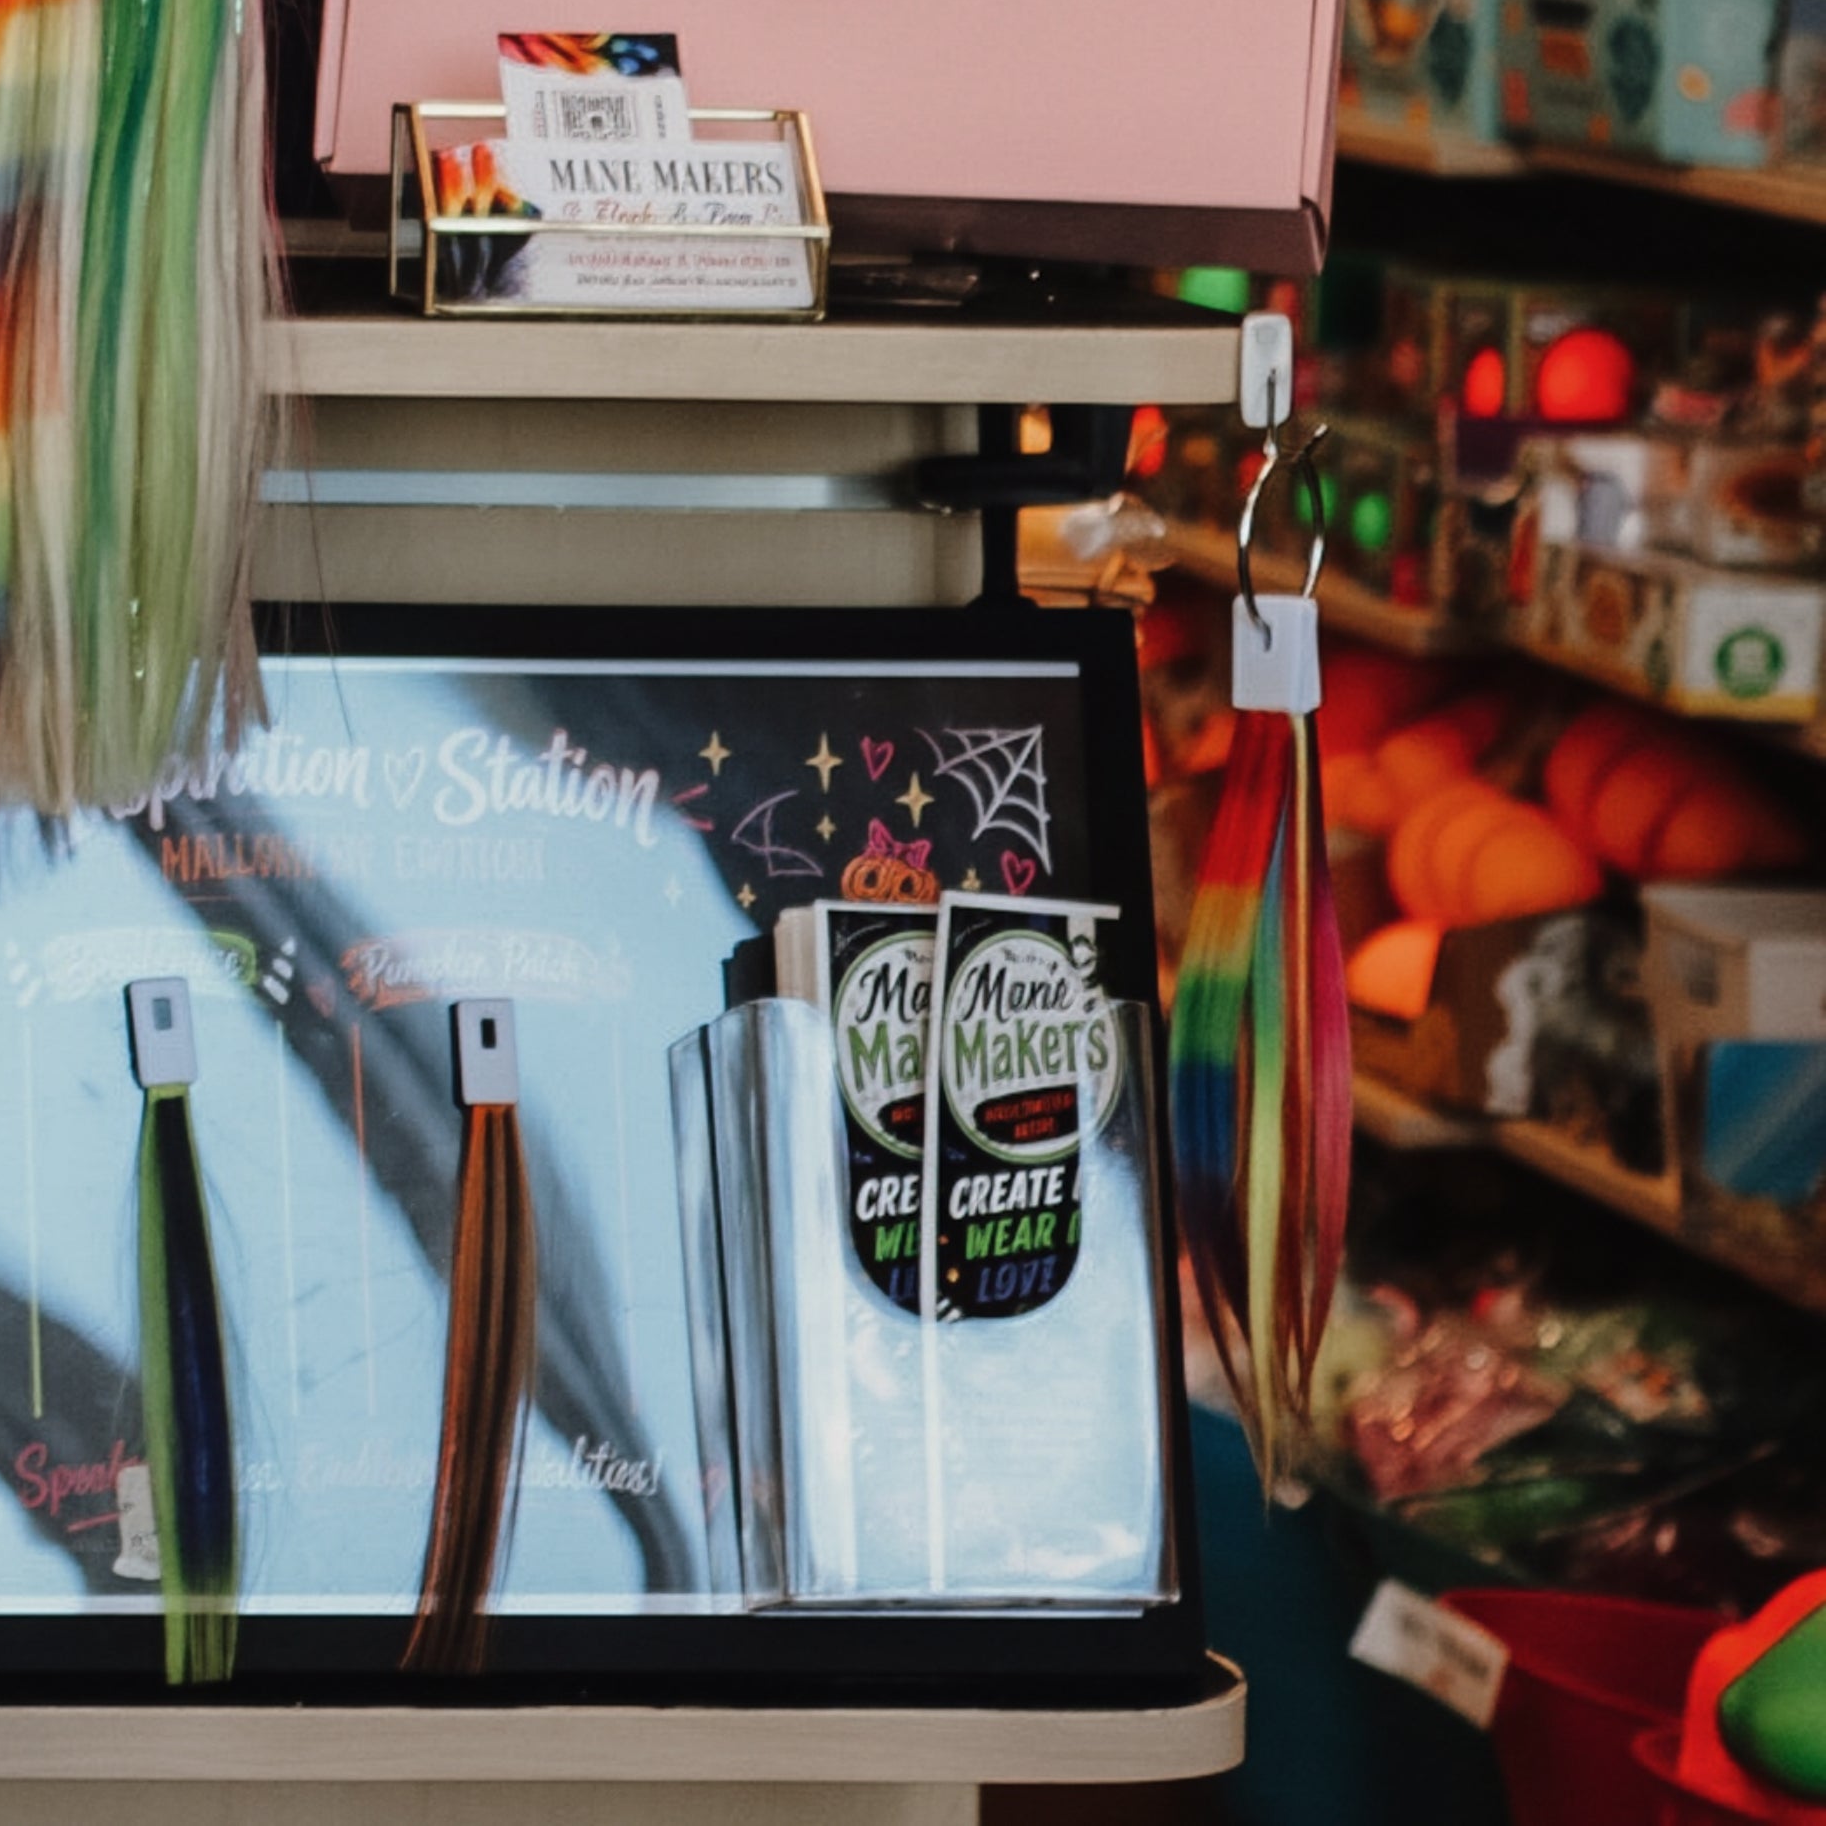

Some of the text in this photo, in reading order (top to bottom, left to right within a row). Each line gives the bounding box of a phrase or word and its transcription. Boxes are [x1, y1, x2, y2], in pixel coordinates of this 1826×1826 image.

[433, 725, 661, 848] Station
[855, 962, 931, 1025] Ma
[953, 1018, 1109, 1091] Makers
[855, 1174, 921, 1222] CRE
[949, 1165, 1066, 1221] CREATE
[964, 1211, 1058, 1261] WEAR
